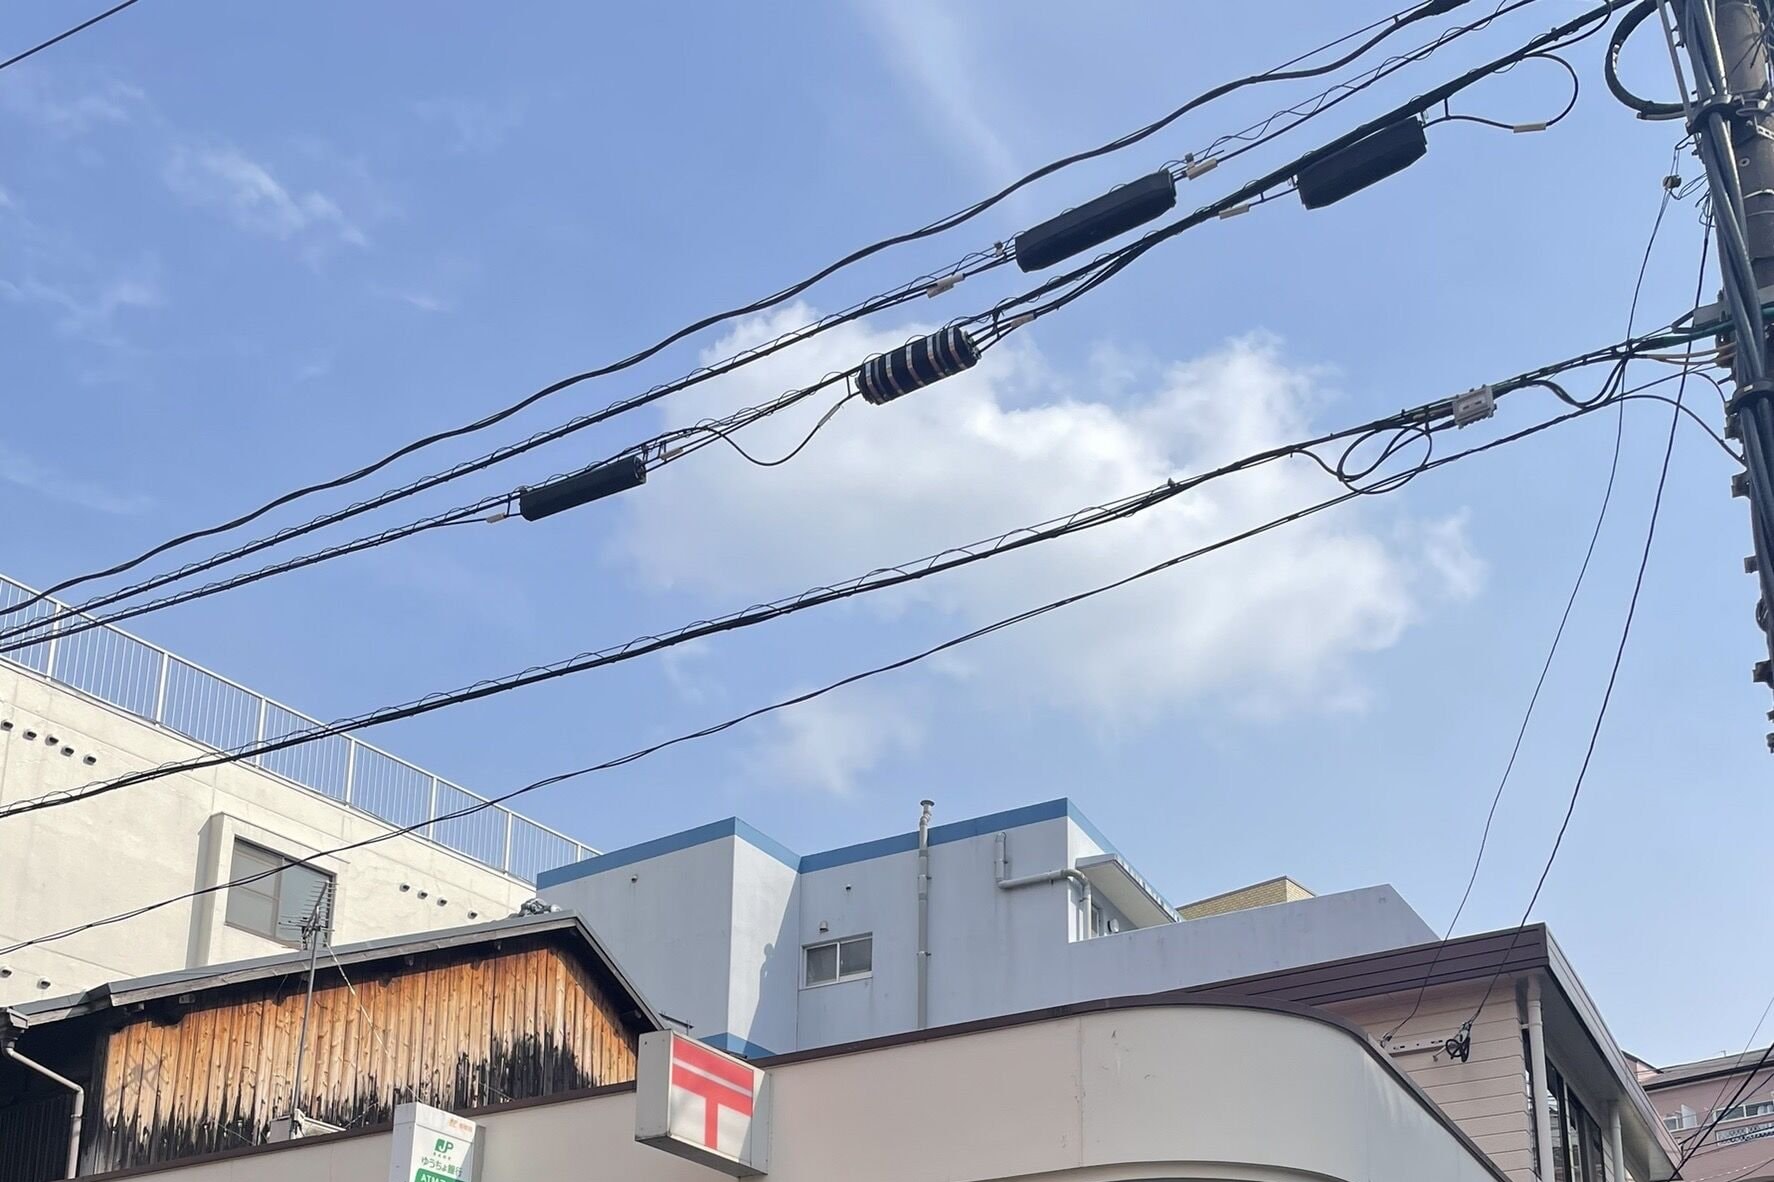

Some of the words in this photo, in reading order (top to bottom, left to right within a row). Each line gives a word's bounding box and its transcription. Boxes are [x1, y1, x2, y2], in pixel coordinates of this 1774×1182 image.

[421, 1156, 464, 1177] ゆうちょ銀行
